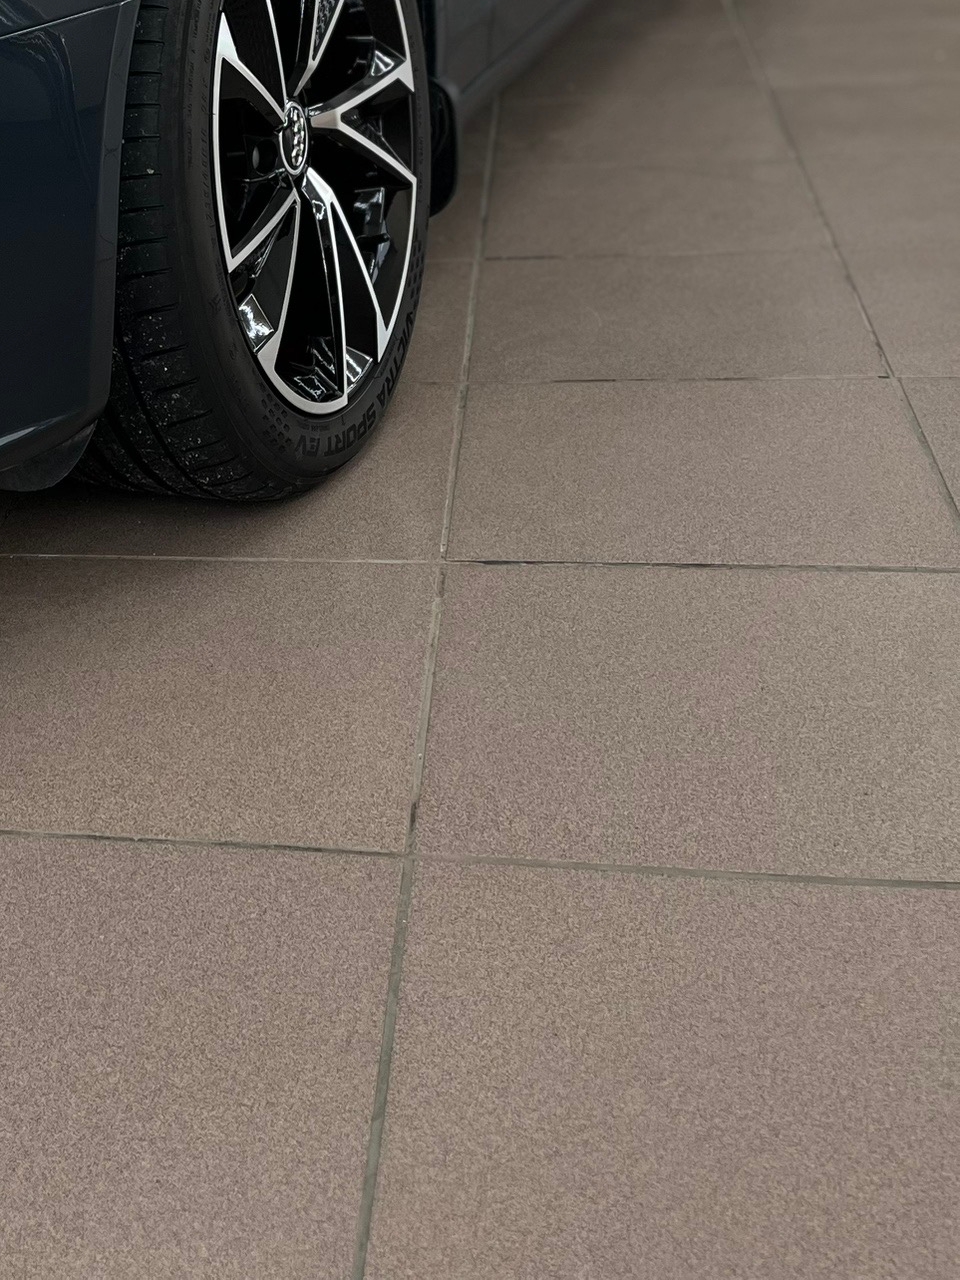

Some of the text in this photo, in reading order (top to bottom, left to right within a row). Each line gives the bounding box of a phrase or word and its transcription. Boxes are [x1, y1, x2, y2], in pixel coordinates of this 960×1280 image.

[376, 311, 414, 410] VICTRA
[294, 434, 321, 458] EV
[323, 402, 377, 457] SPORT
